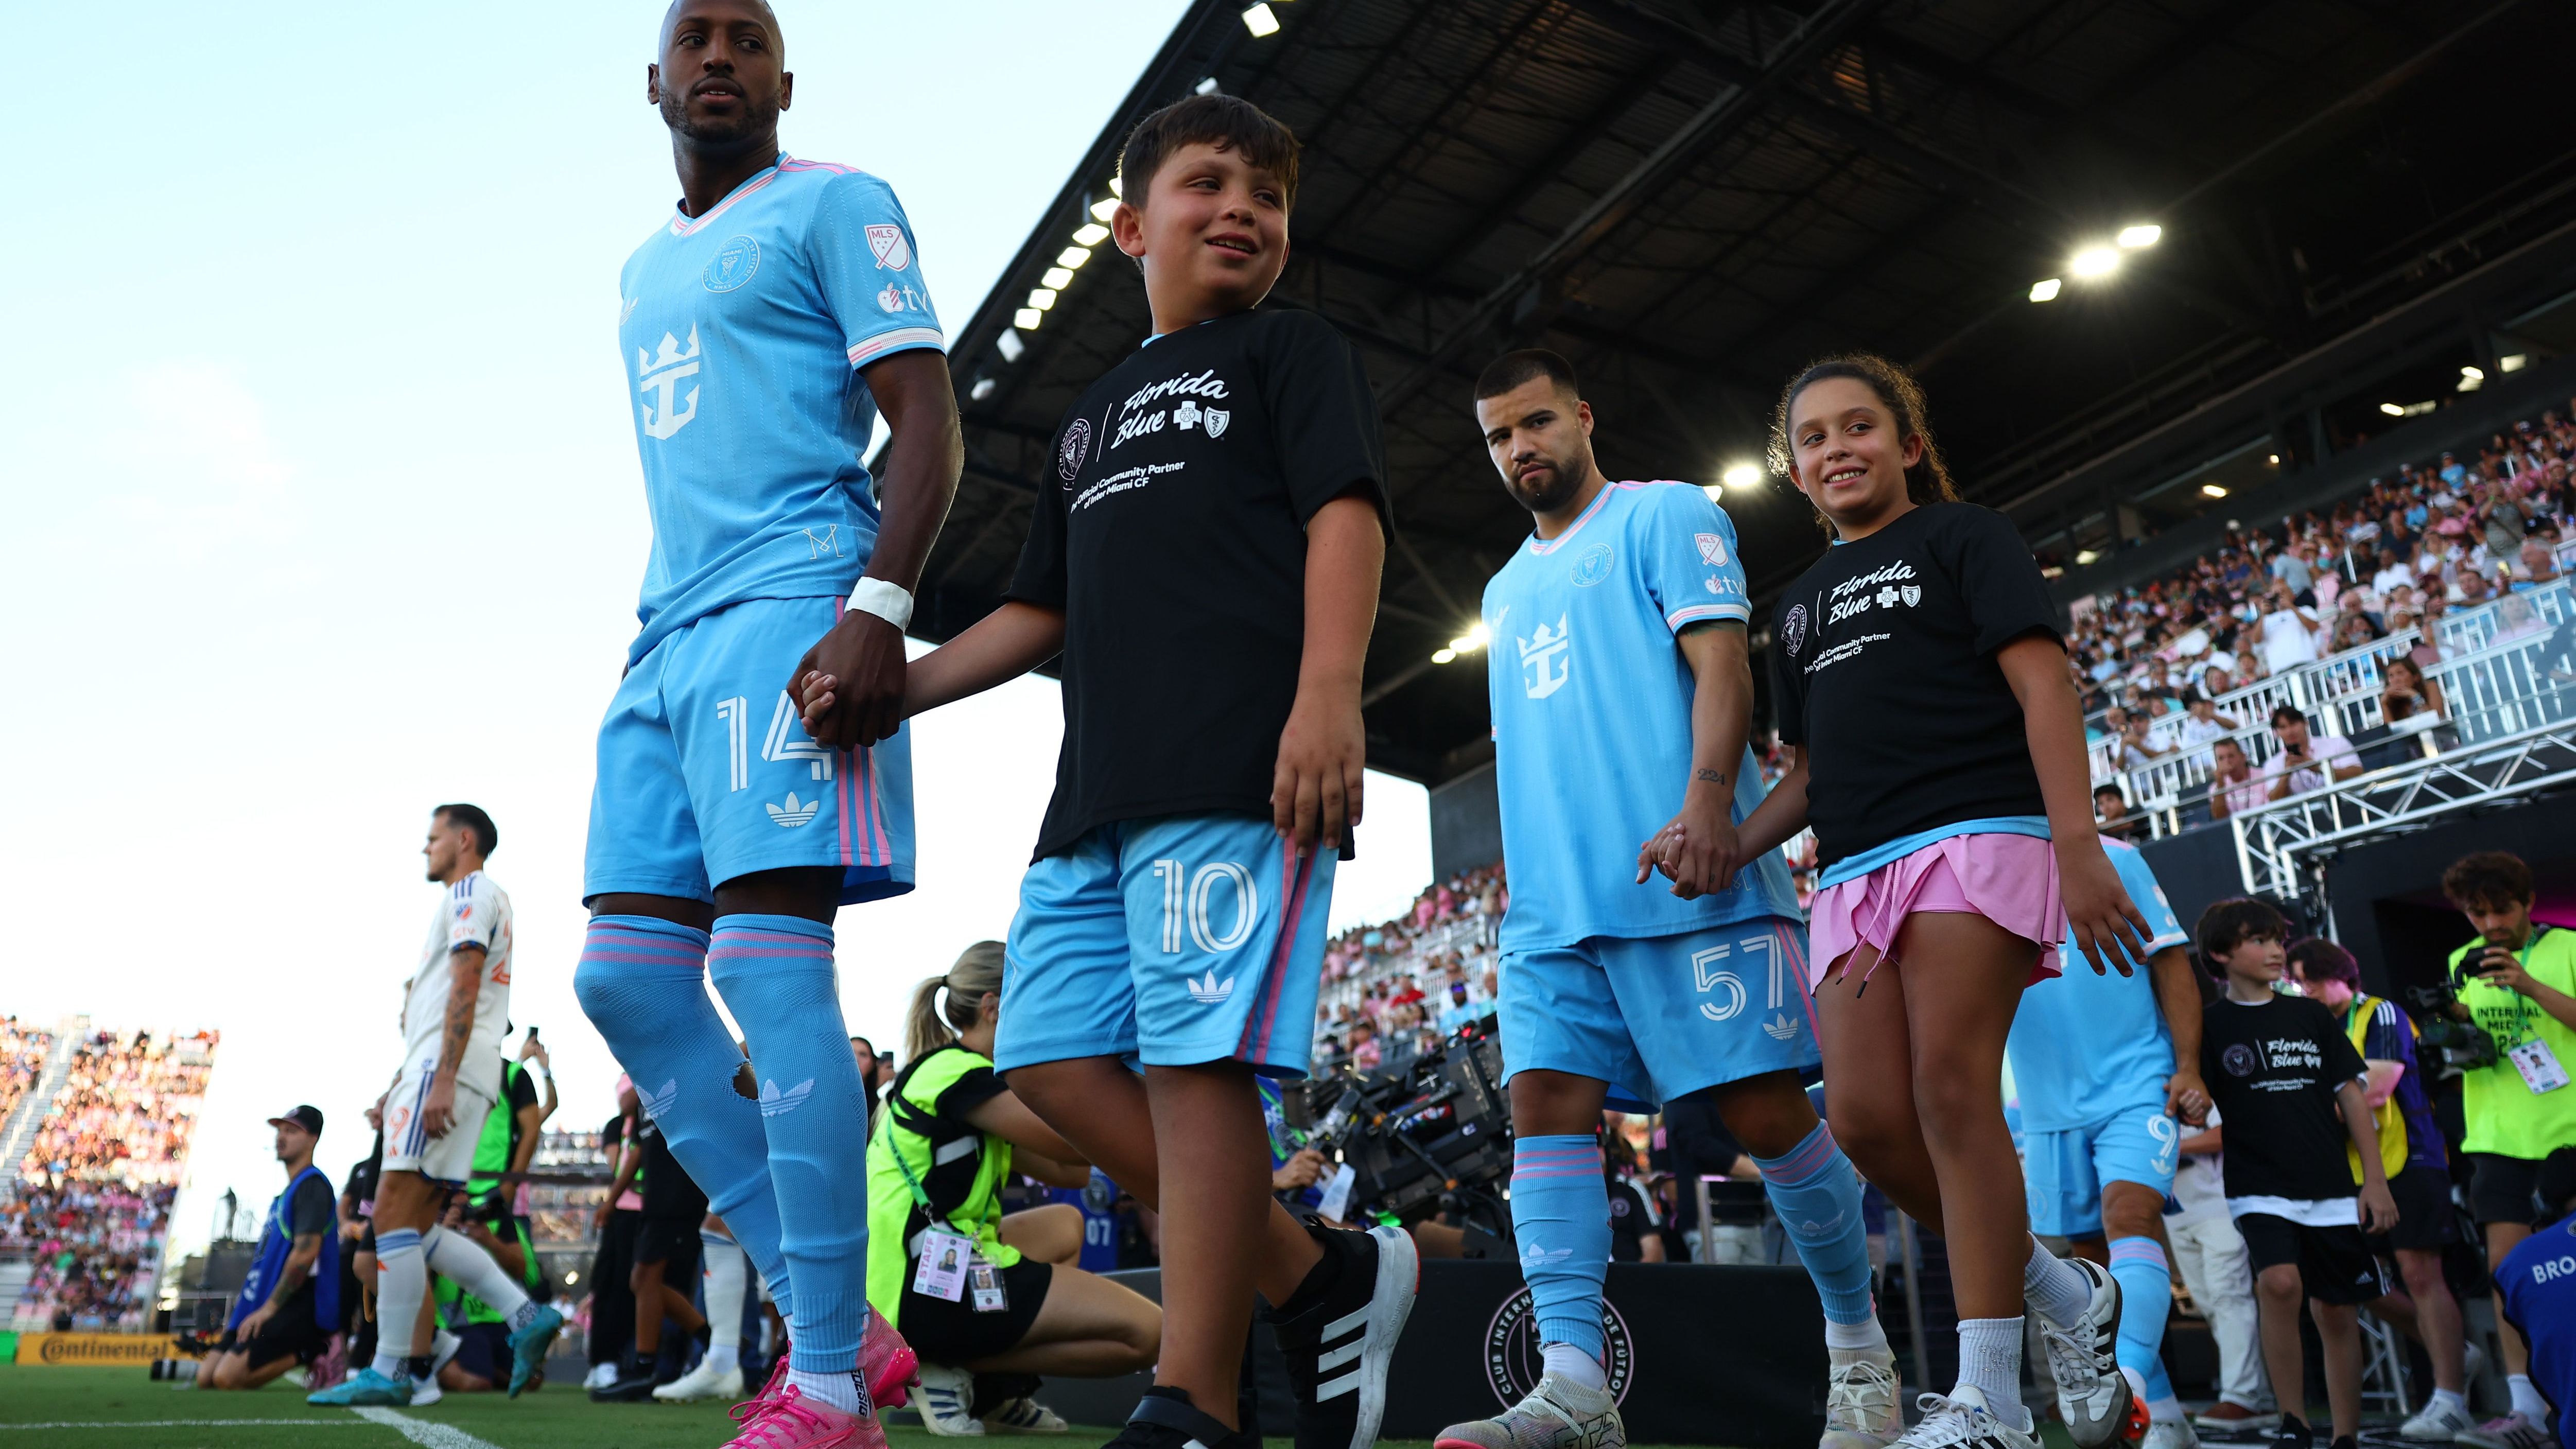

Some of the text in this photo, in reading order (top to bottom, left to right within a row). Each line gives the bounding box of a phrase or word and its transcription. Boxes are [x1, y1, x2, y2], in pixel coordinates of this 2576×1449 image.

[871, 230, 893, 238] MLS
[902, 285, 927, 311] tv
[1119, 369, 1229, 422] Florida
[1111, 409, 1166, 449] Blue
[1077, 482, 1099, 504] Official
[1099, 467, 1146, 489] Community
[1148, 462, 1185, 475] Partner
[1084, 477, 1150, 509] of Inter Miami CF
[1722, 575, 1742, 596] tv
[1830, 560, 1916, 603] Florida
[1828, 595, 1871, 625] Blue
[1816, 645, 1863, 672] of Inter Miami CF
[1826, 639, 1860, 657] Community
[1861, 633, 1890, 643] Partner
[717, 690, 832, 792] 14
[1154, 859, 1258, 954] 10
[1691, 934, 1783, 1021] 57
[2478, 1007, 2542, 1019] INTERAL
[2266, 1037, 2320, 1054] Florida
[2271, 1052, 2303, 1068] Blue
[389, 1106, 410, 1141] 9
[2147, 1114, 2177, 1158] 9
[1086, 1217, 1112, 1247] 07
[918, 1237, 934, 1278] STAFF
[1493, 1354, 1512, 1395] CLUB
[1604, 1315, 1620, 1334] DE
